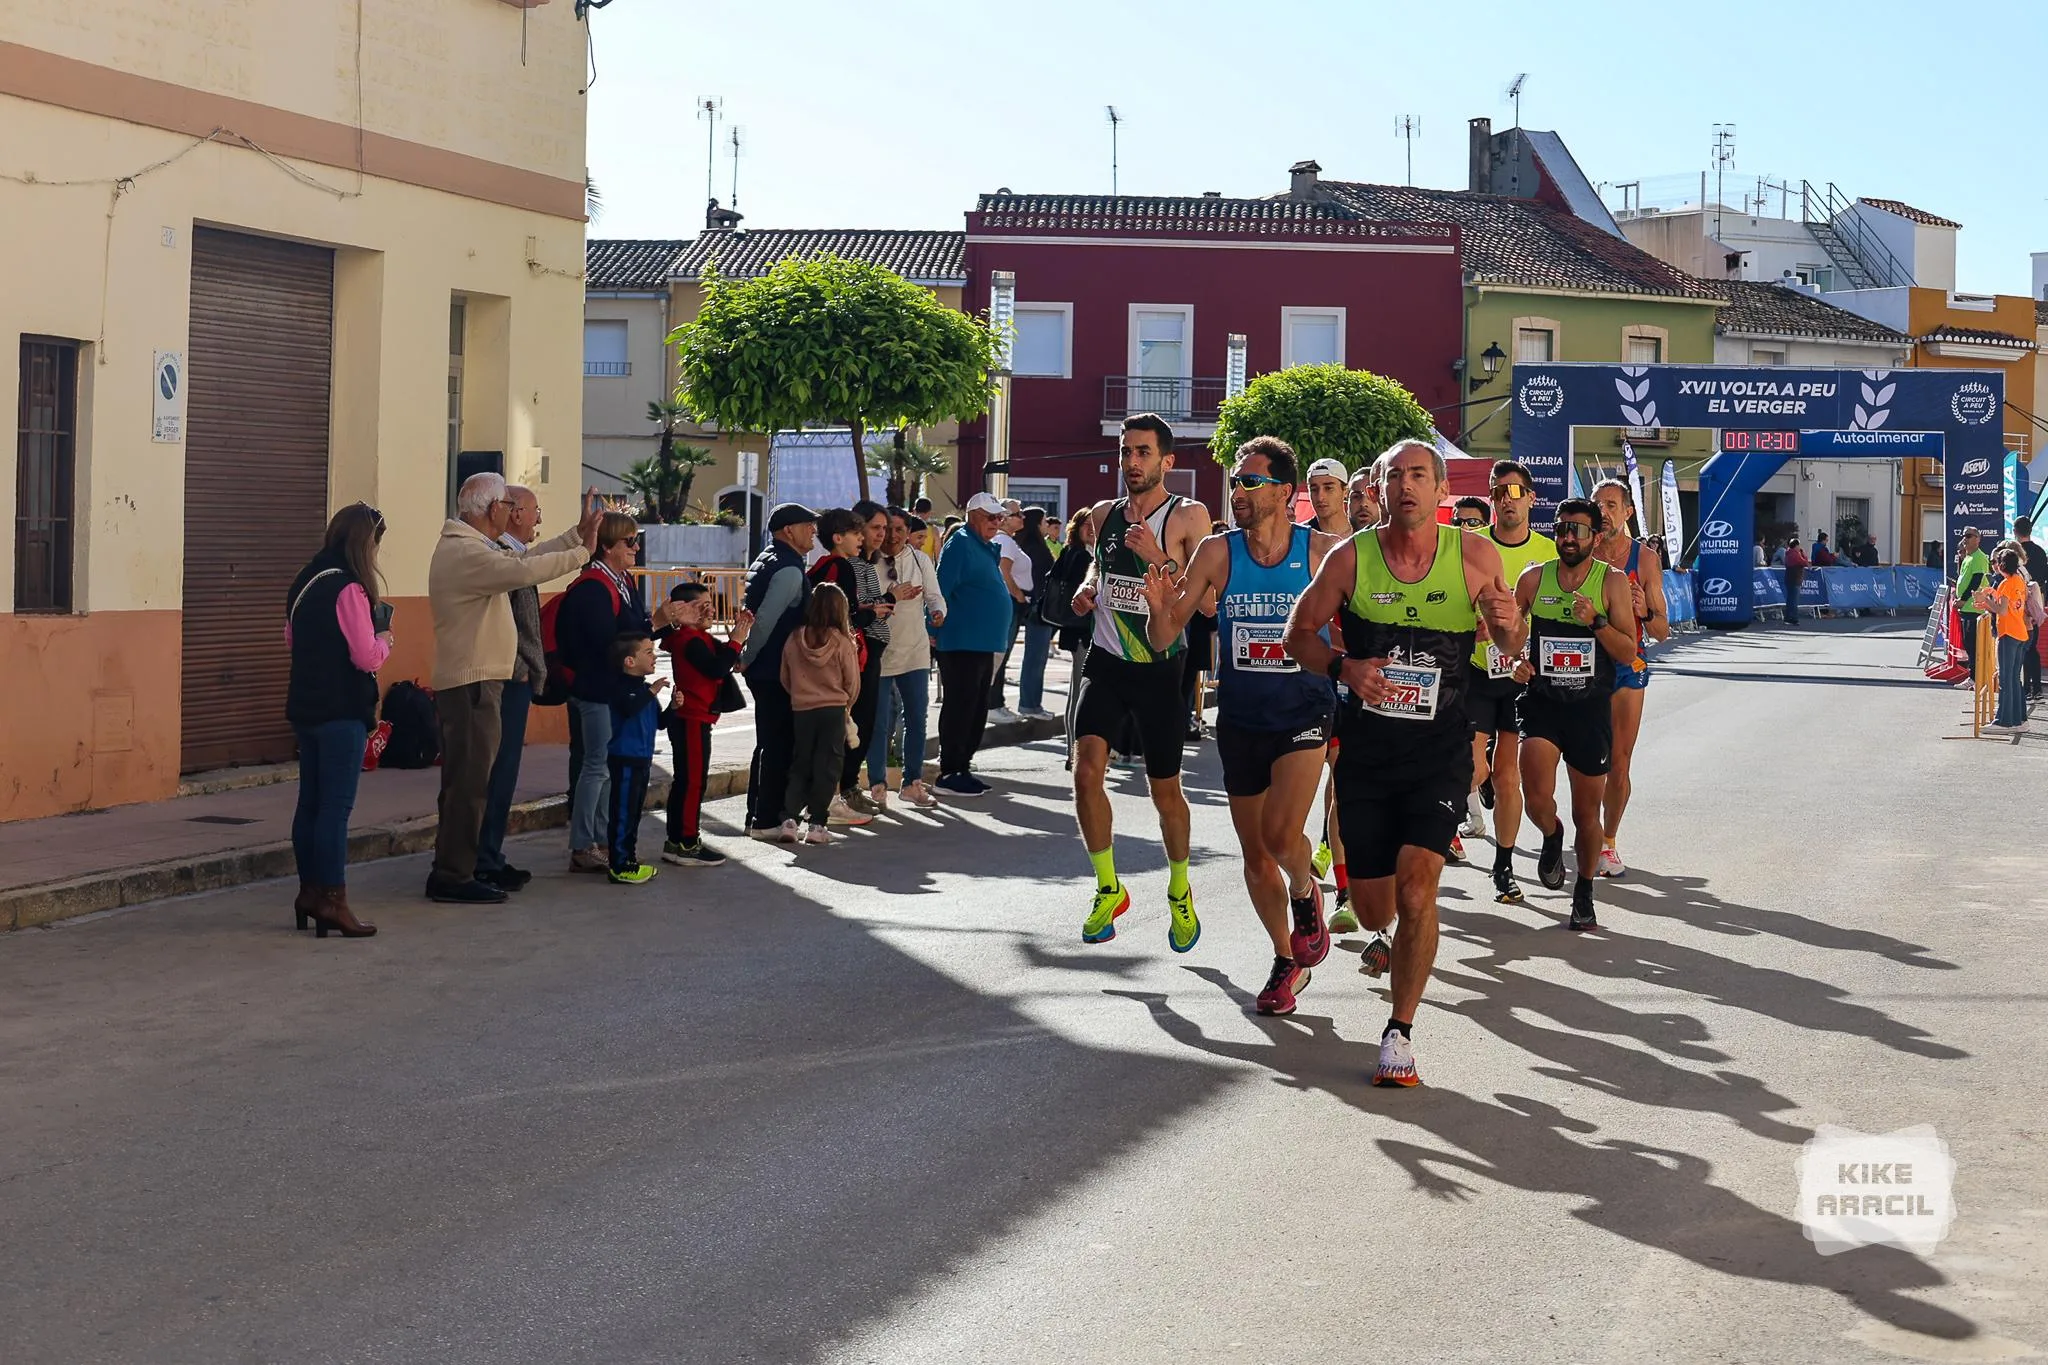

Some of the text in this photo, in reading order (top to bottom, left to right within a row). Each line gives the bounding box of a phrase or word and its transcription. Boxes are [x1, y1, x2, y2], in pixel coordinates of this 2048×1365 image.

[1679, 380, 1837, 397] XVII VOLTA A PEU
[1707, 399, 1807, 415] EL VERGER
[1725, 432, 1795, 449] 00:12:30
[1832, 431, 1925, 444] Autoalmenar
[1518, 455, 1563, 466] BALEARIA
[1239, 646, 1271, 658] B 7
[1493, 658, 1499, 667] S
[1546, 655, 1570, 666] S 8
[1384, 689, 1417, 704] 472
[1380, 702, 1417, 712] BALEARIA
